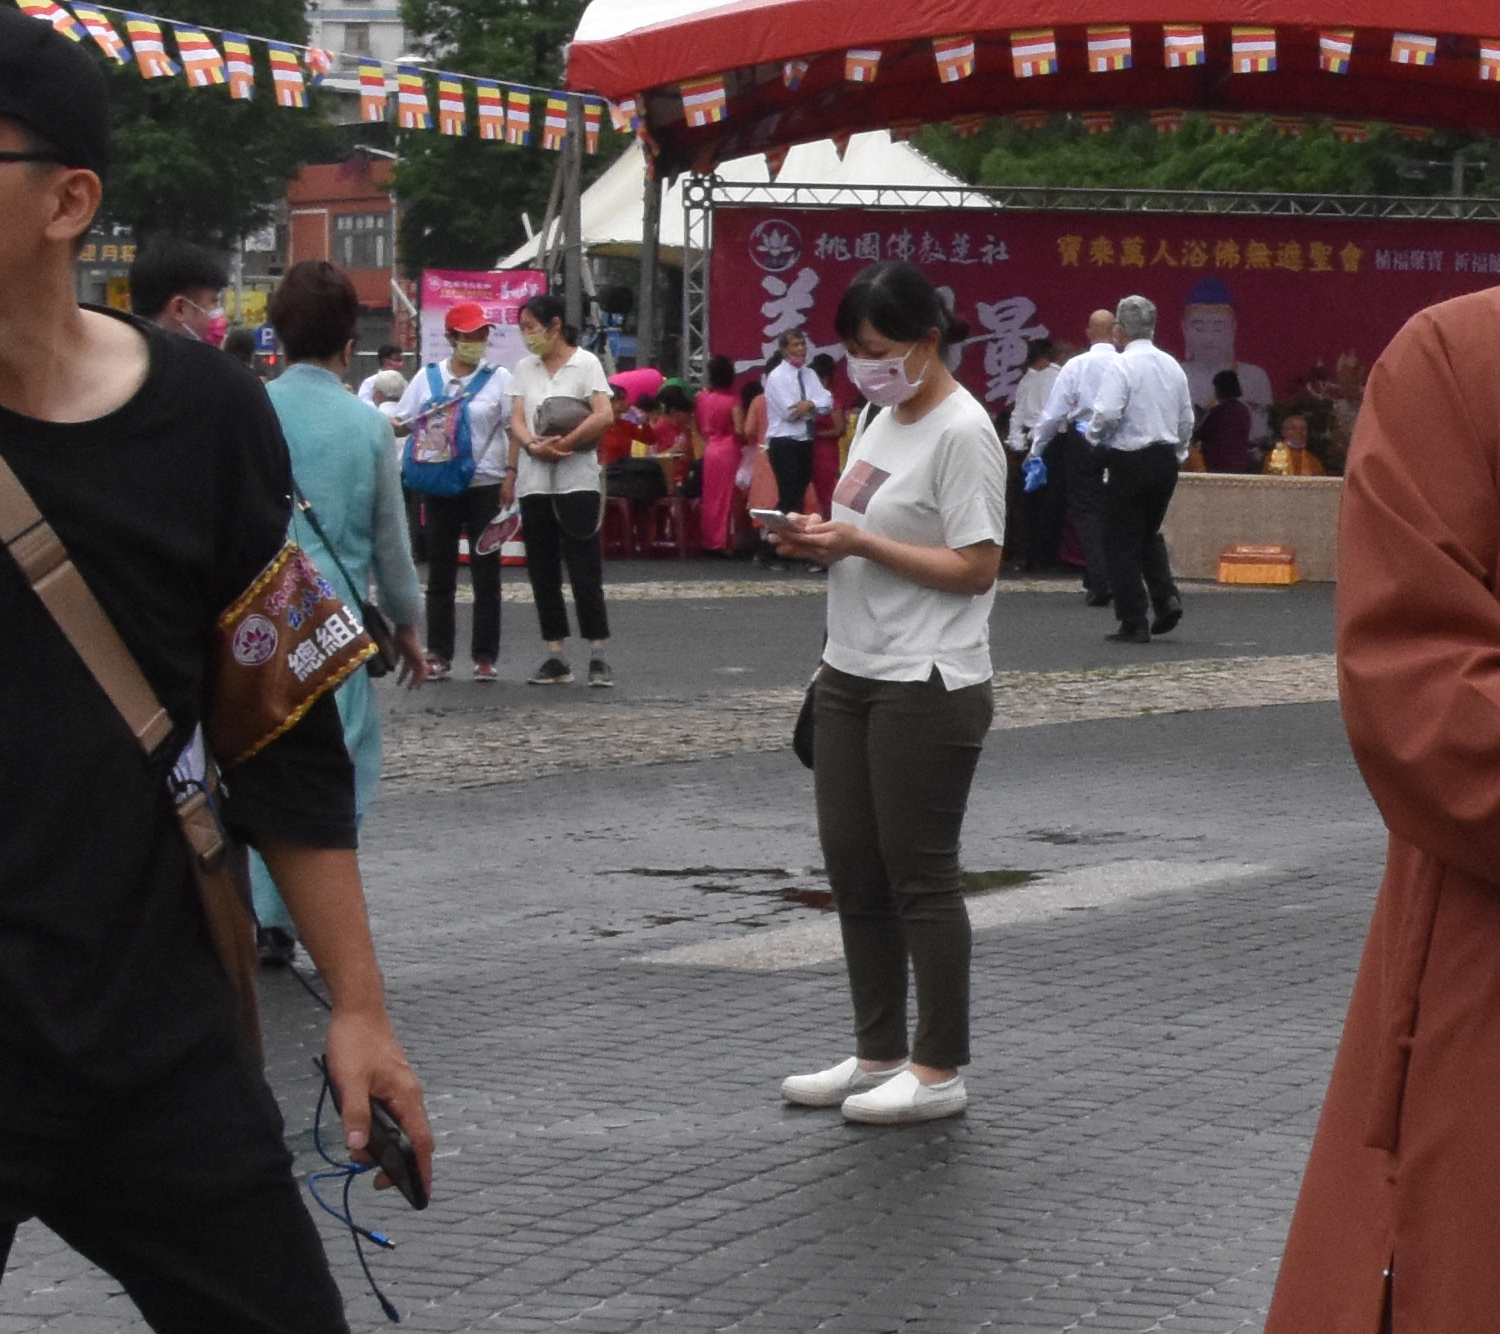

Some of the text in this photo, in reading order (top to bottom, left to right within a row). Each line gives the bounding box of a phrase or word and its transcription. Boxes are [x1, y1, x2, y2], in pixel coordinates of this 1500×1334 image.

[815, 229, 1010, 264] 桃園佛教蓮社
